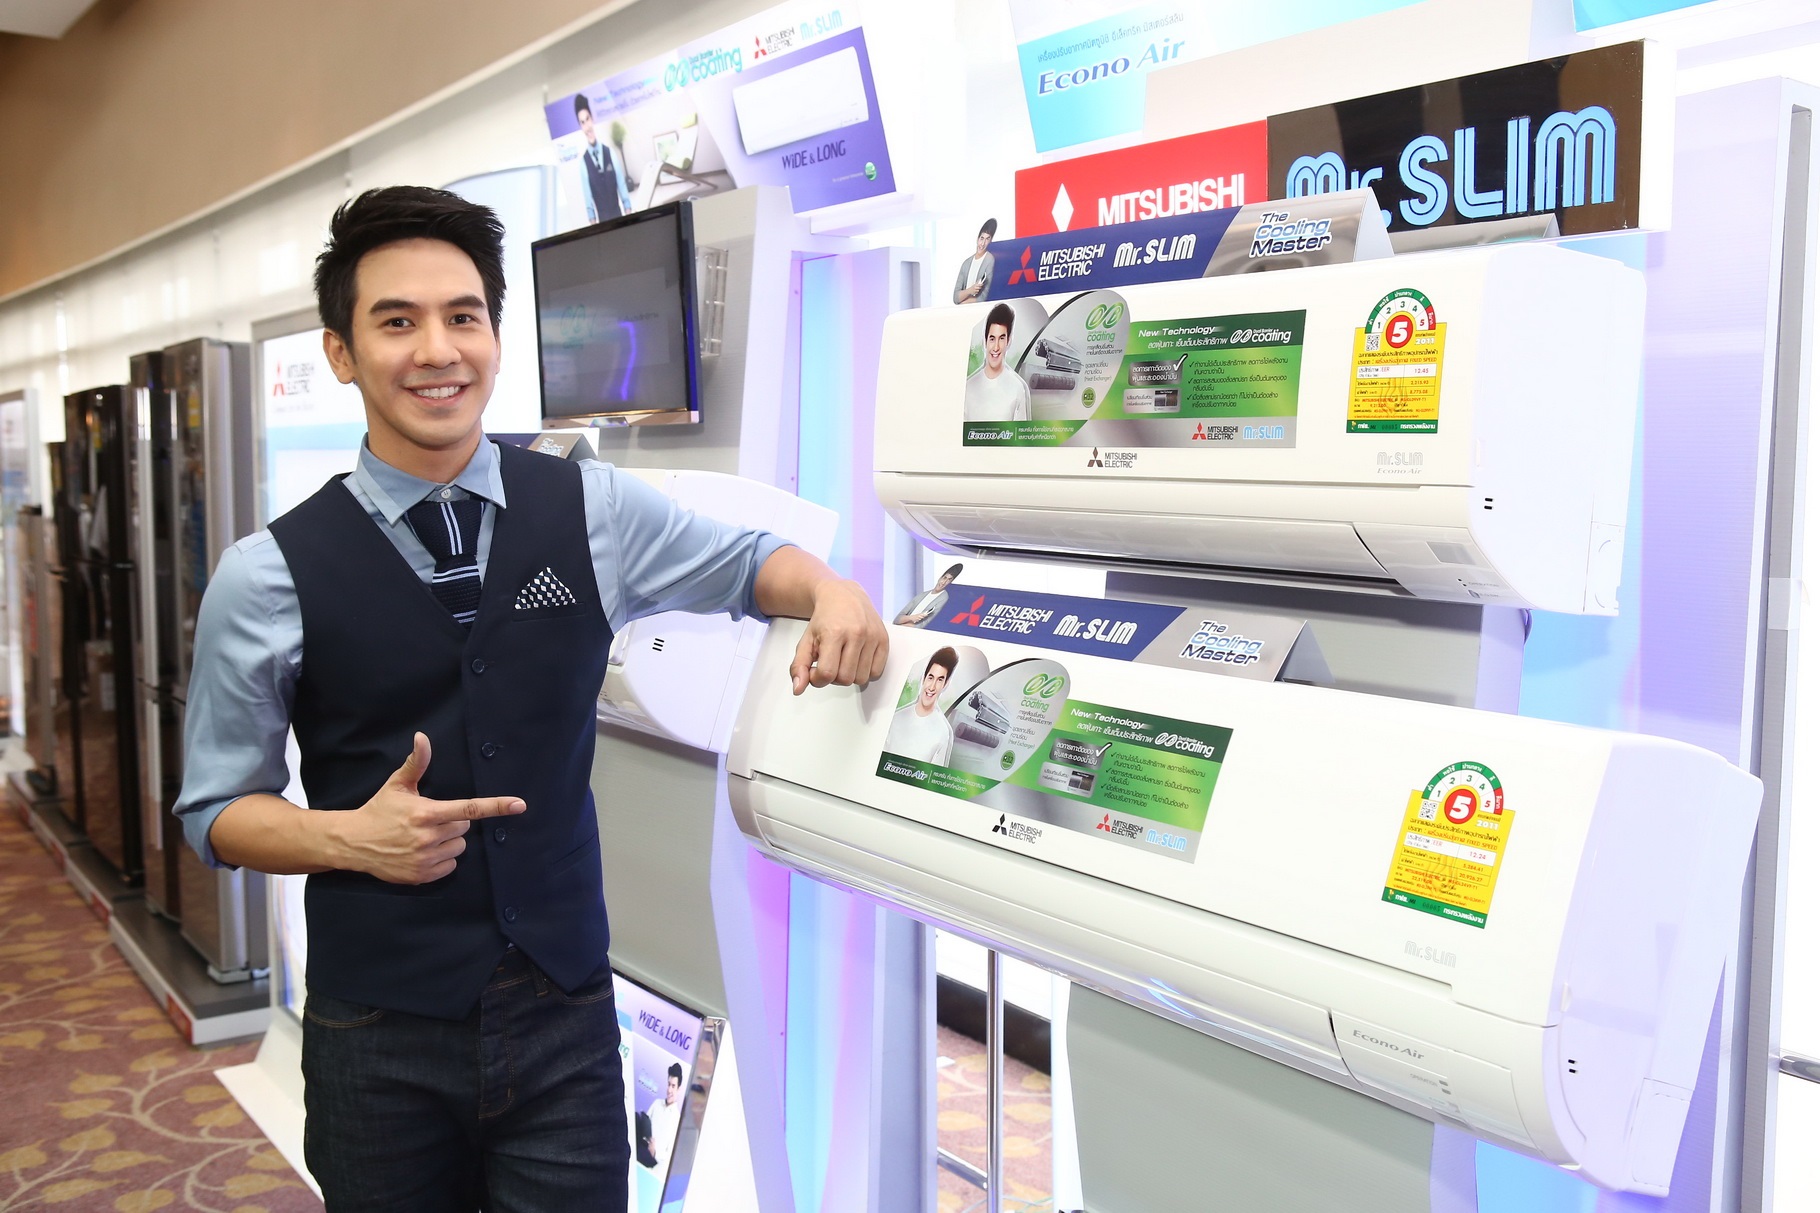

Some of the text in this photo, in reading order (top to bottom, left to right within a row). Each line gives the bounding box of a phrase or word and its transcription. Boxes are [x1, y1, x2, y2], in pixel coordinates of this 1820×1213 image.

[765, 27, 795, 44] MITSUBISHI
[767, 38, 793, 54] ELECTRIC
[691, 47, 743, 82] coating
[1039, 38, 1185, 94] Econo Air
[810, 153, 816, 164] &
[817, 140, 846, 162] LONG
[1098, 174, 1245, 226] MITSUBISHI
[1261, 211, 1288, 223] The
[1256, 217, 1329, 240] Cooling
[1040, 243, 1106, 266] MITSUBISHI
[1250, 234, 1331, 257] Master
[1038, 262, 1093, 282] ELECTRIC
[1087, 332, 1115, 342] coating
[1138, 325, 1215, 337] New Technology
[1251, 329, 1291, 344] coating
[1391, 321, 1408, 344] 5
[968, 430, 1013, 440] Econo Air
[1104, 452, 1137, 460] MITSUBISHI
[1104, 460, 1133, 468] ELECTRIC
[988, 603, 1053, 622] MITSUBISHI
[979, 616, 1033, 635] ELECTRIC
[1200, 621, 1227, 634] The
[1191, 632, 1263, 653] Cooling
[1180, 644, 1259, 666] Master
[1021, 699, 1050, 713] coating
[1070, 708, 1144, 730] New Technology
[1175, 740, 1215, 758] coating
[911, 770, 928, 780] Air
[1449, 777, 1456, 785] 2
[1484, 800, 1491, 808] 5
[1448, 795, 1472, 820] 5
[1010, 822, 1042, 838] MITSUBISHI
[1111, 827, 1138, 840] ELECTRIC
[1113, 819, 1144, 833] MITSUBISHI
[1476, 819, 1499, 831] 2011
[1008, 829, 1037, 844] ELECTRIC
[1469, 851, 1486, 860] 12.24
[659, 1026, 664, 1037] &
[665, 1026, 692, 1050] LONG
[1352, 1029, 1424, 1060] Econo Air
